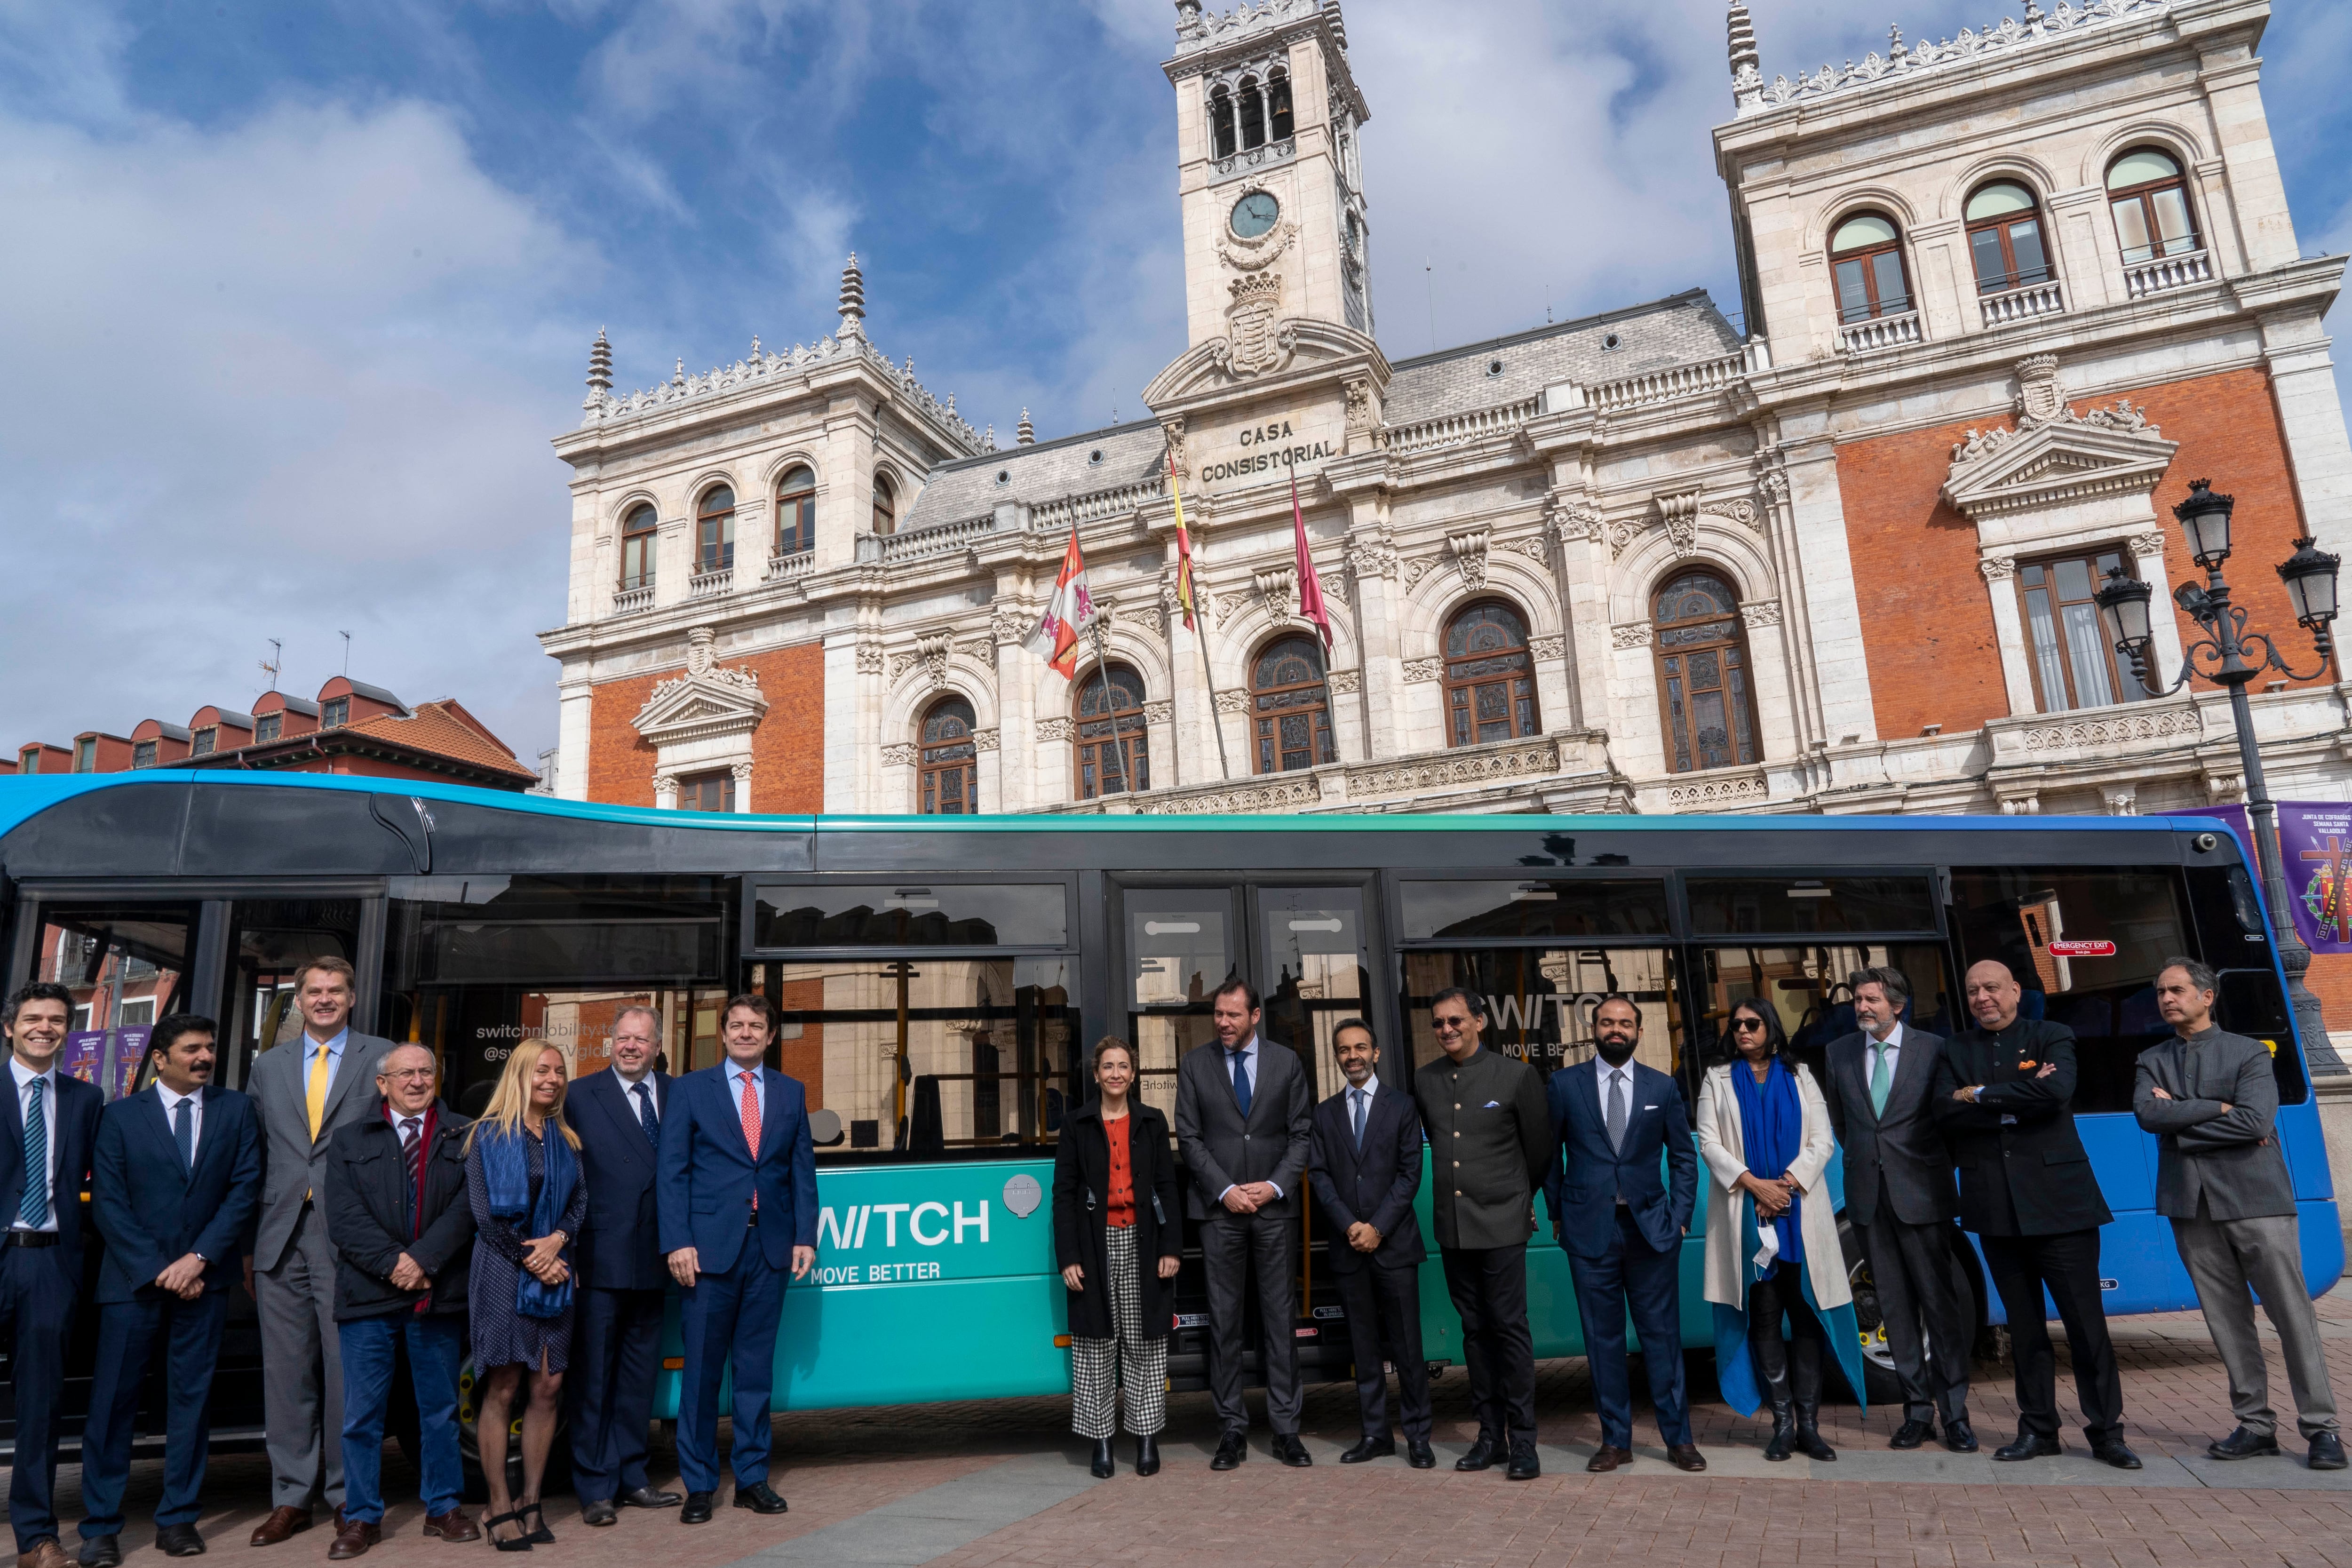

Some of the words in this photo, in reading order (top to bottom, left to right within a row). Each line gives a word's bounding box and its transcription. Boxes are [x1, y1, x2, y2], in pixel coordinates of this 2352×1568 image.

[1240, 421, 1294, 446] CASA
[1202, 440, 1337, 482] CONSISTORIAL
[1478, 993, 1635, 1030] WITC
[1502, 1043, 1541, 1058] MOVE
[1547, 1042, 1597, 1056] BETTE
[810, 1266, 859, 1285] MOVE
[869, 1262, 940, 1282] BETTER
